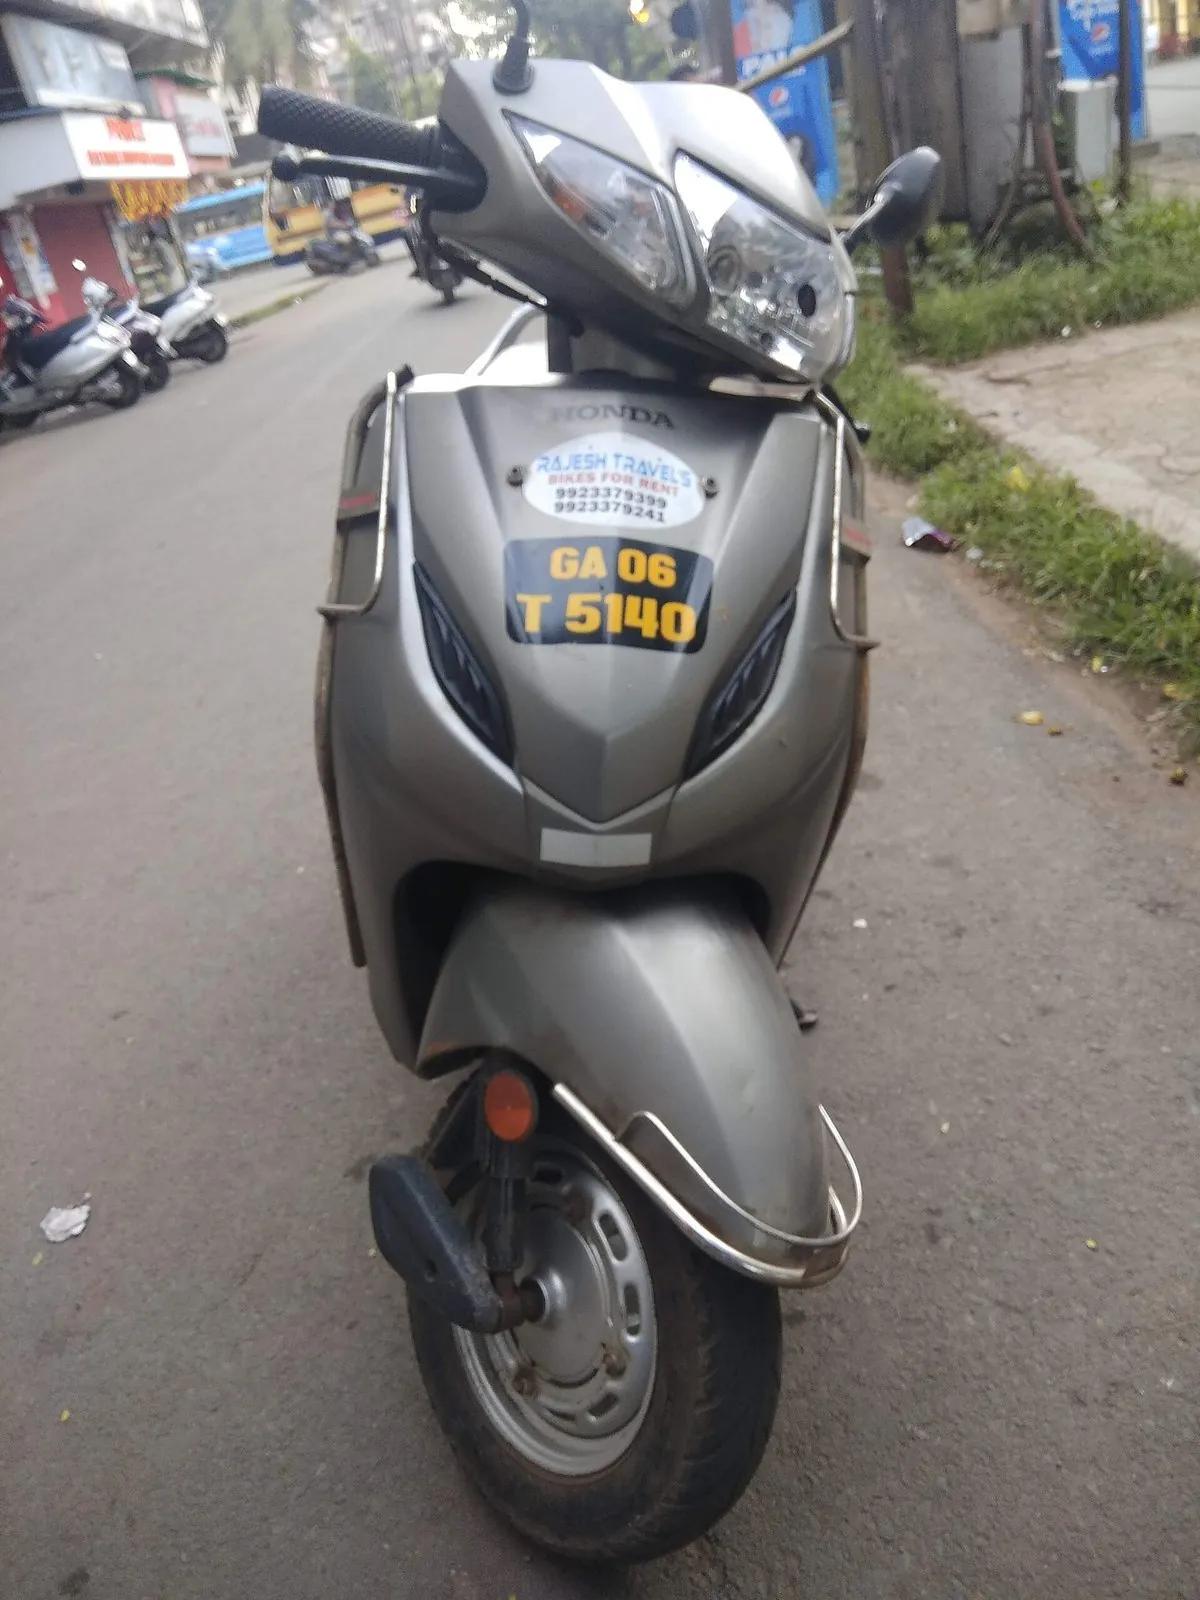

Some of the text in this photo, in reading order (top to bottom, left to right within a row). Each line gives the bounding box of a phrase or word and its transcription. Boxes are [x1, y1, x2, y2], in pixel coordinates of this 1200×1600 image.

[549, 405, 674, 429] HONDA
[536, 453, 608, 473] RAJESH
[548, 472, 679, 497] BIKES FOR RENT
[554, 501, 665, 522] 9923379241
[550, 546, 677, 588] GA 06
[516, 592, 697, 643] T 5140
